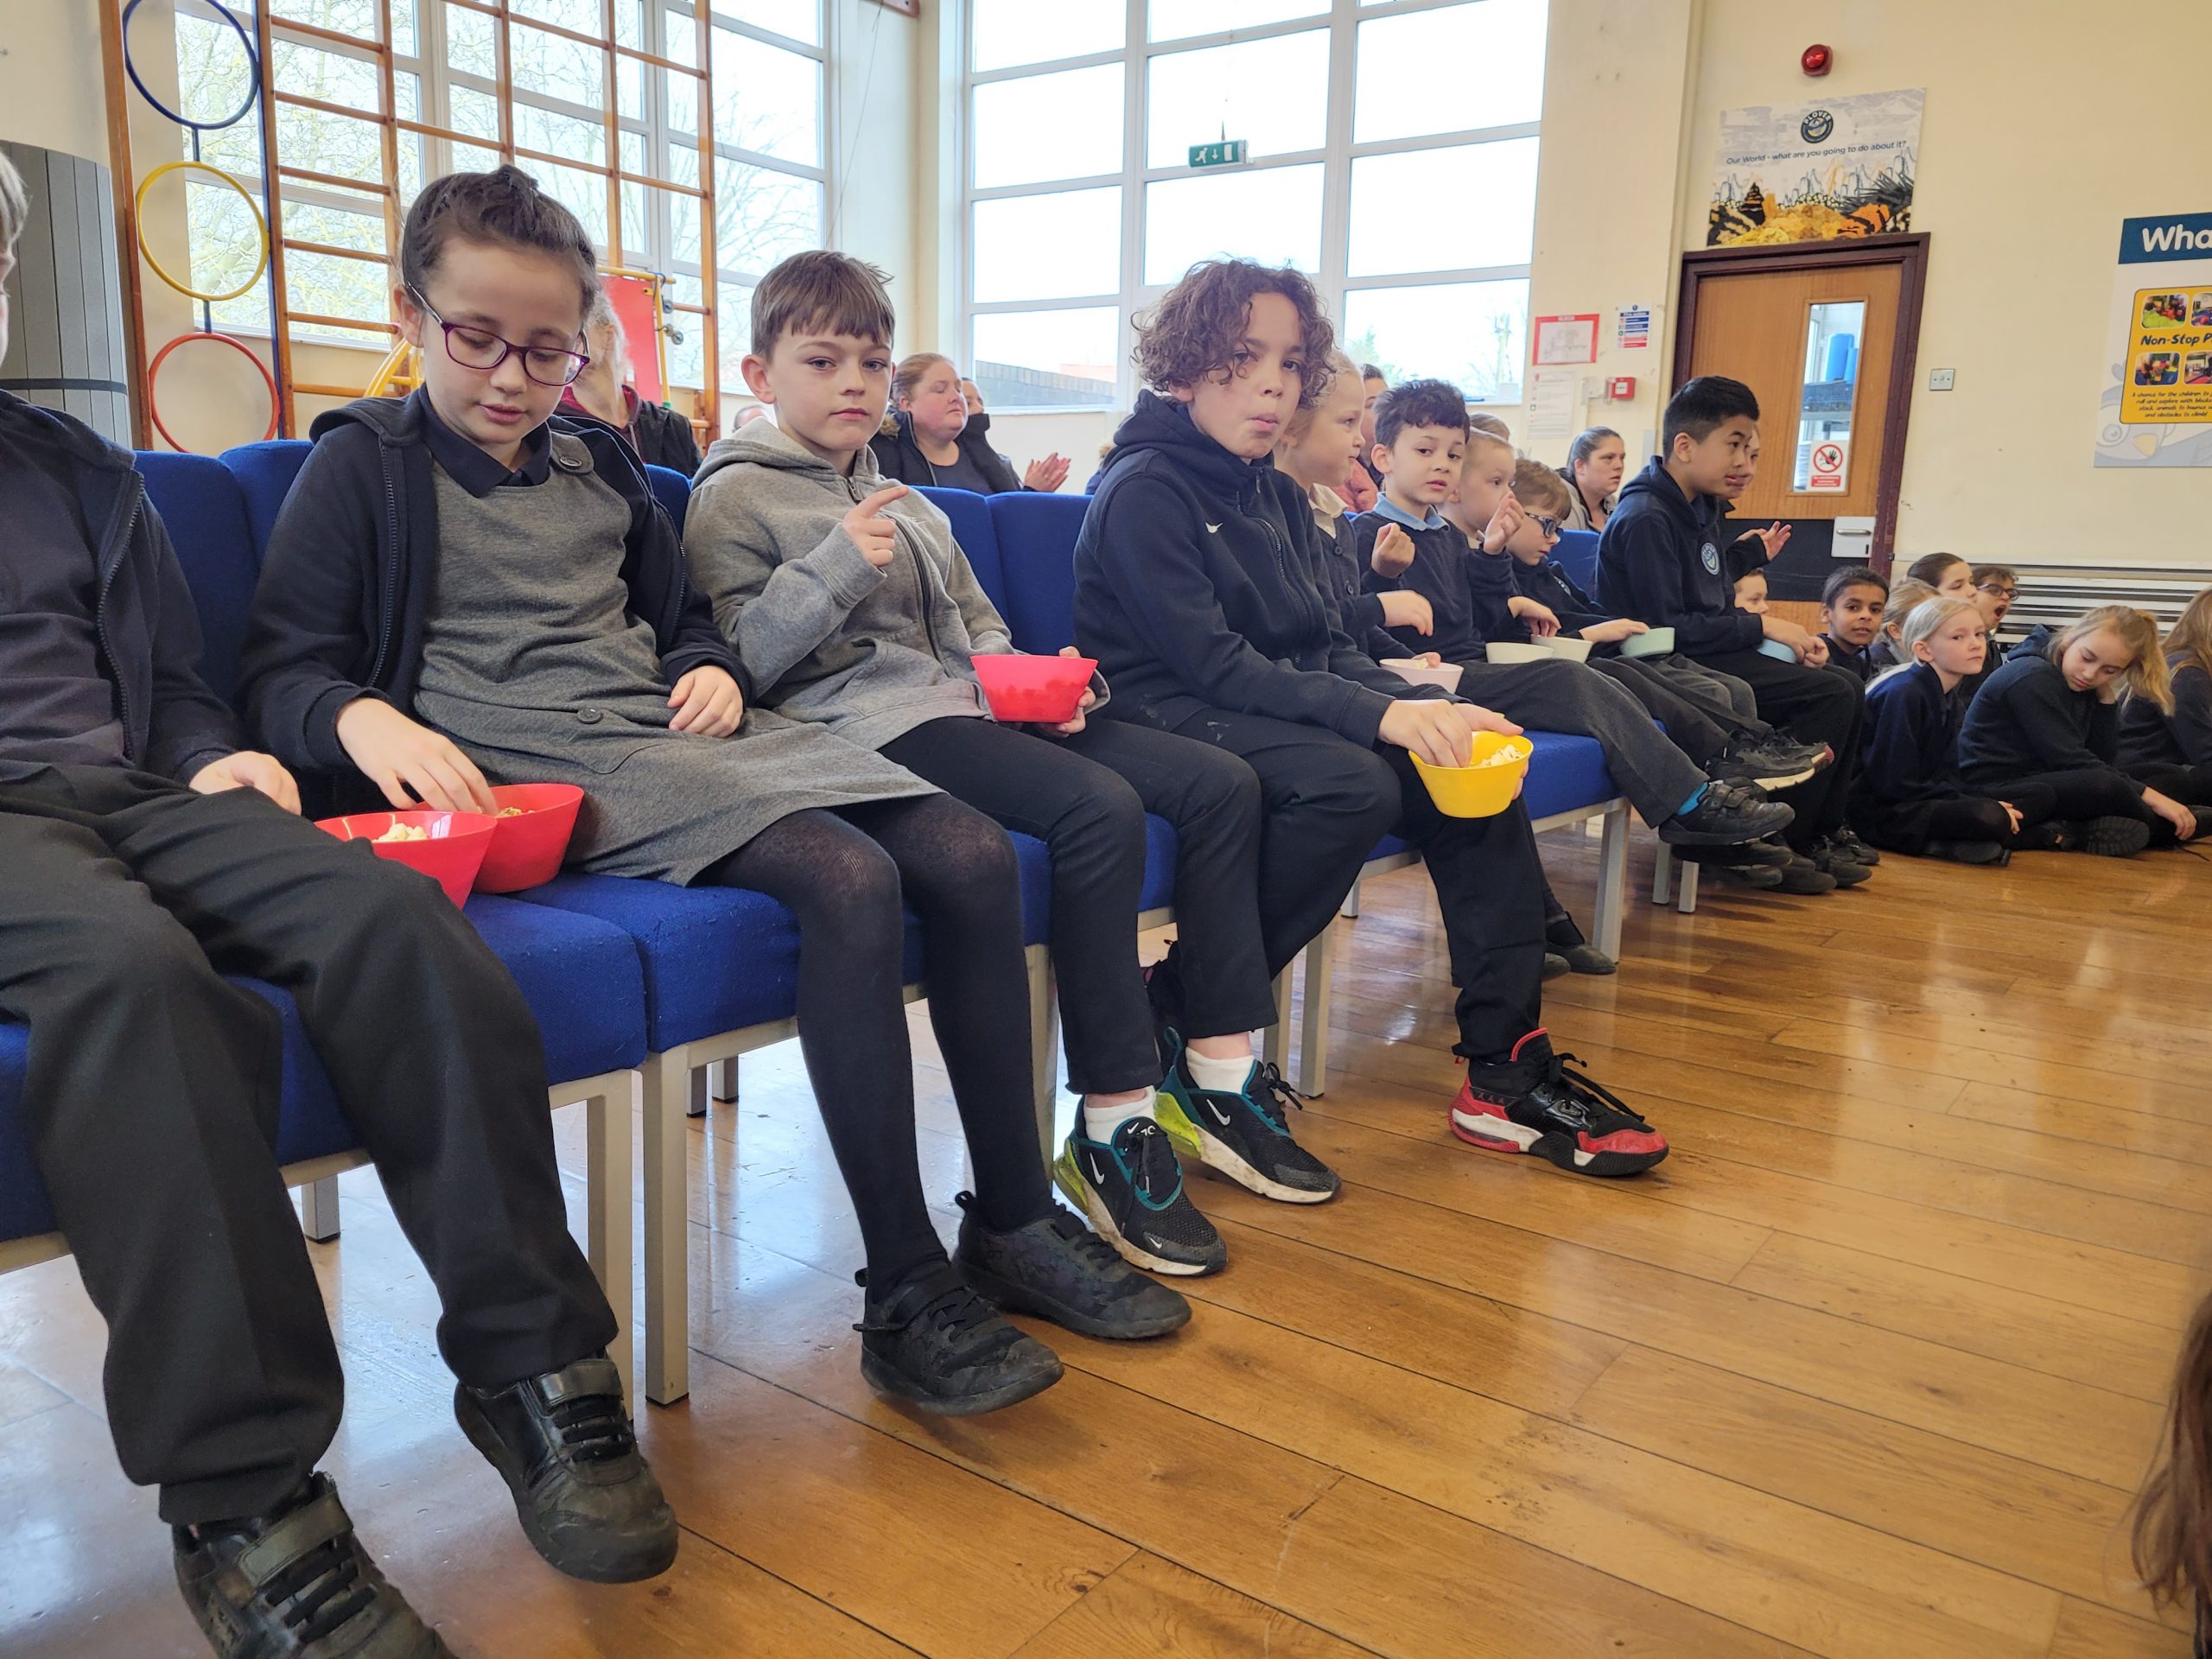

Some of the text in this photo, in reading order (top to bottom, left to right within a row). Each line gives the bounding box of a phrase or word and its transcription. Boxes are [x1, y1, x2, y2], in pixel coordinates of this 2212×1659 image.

[1803, 111, 1831, 124] PLOVER
[1742, 155, 1765, 163] World
[1822, 147, 1846, 156] going
[1871, 142, 1895, 150] about
[1896, 140, 1907, 149] it?
[2140, 332, 2212, 346] Non-Stop P
